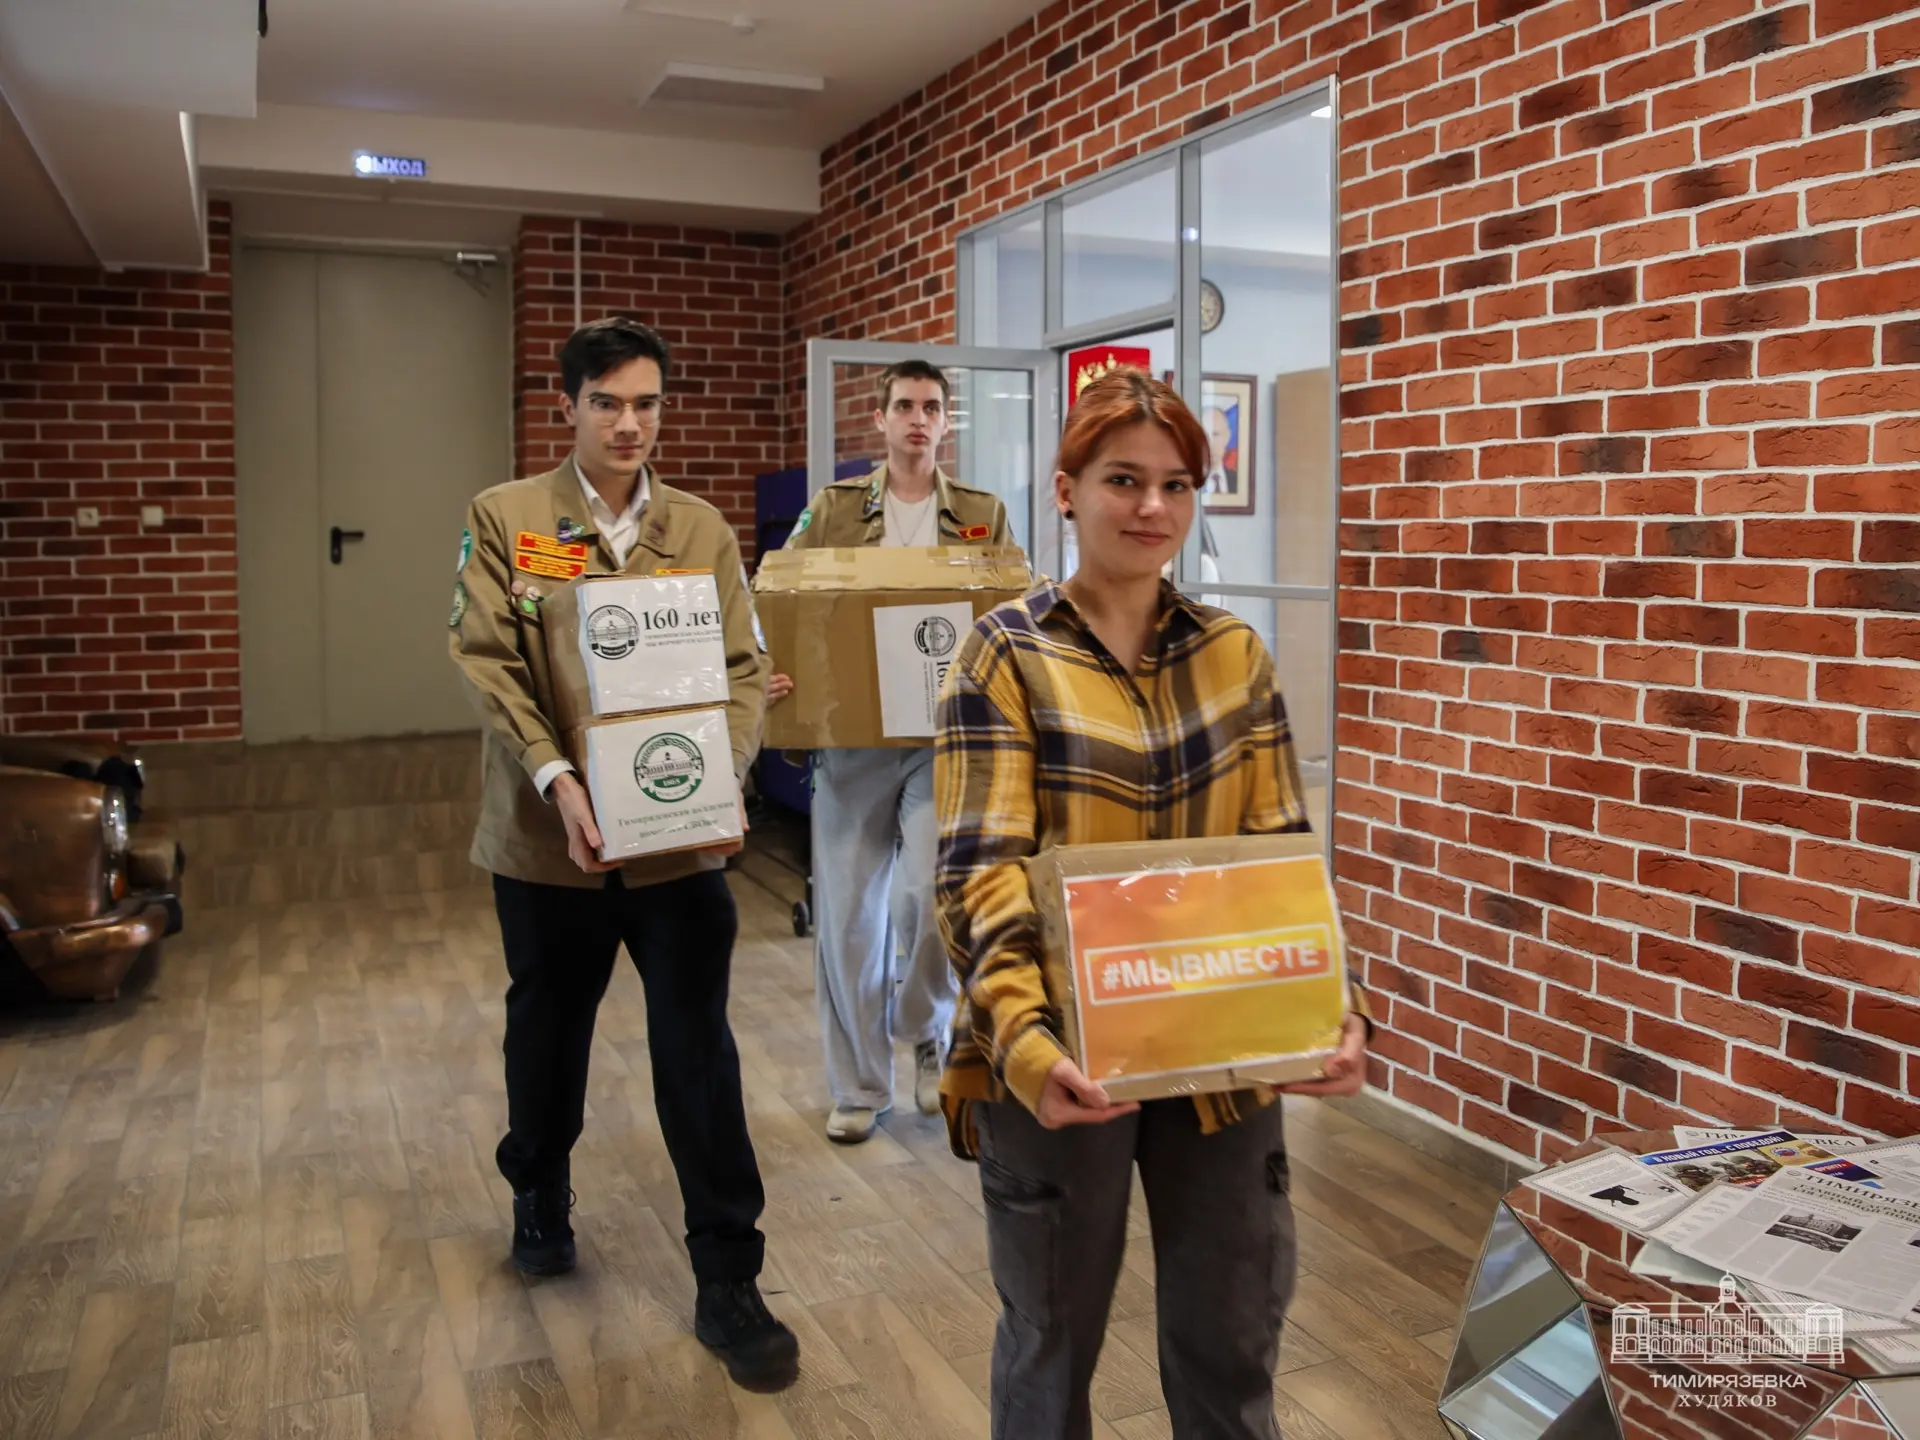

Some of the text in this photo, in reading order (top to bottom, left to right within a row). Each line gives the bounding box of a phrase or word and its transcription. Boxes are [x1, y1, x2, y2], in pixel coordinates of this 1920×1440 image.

[642, 607, 721, 630] 160 лет
[1101, 939, 1321, 991] #МЫВМЕСТЕ
[1661, 1150, 1699, 1162] НОВЫЙ
[1699, 1146, 1721, 1157] ГОД
[1737, 1135, 1784, 1150] ПОБЕДОЙ!
